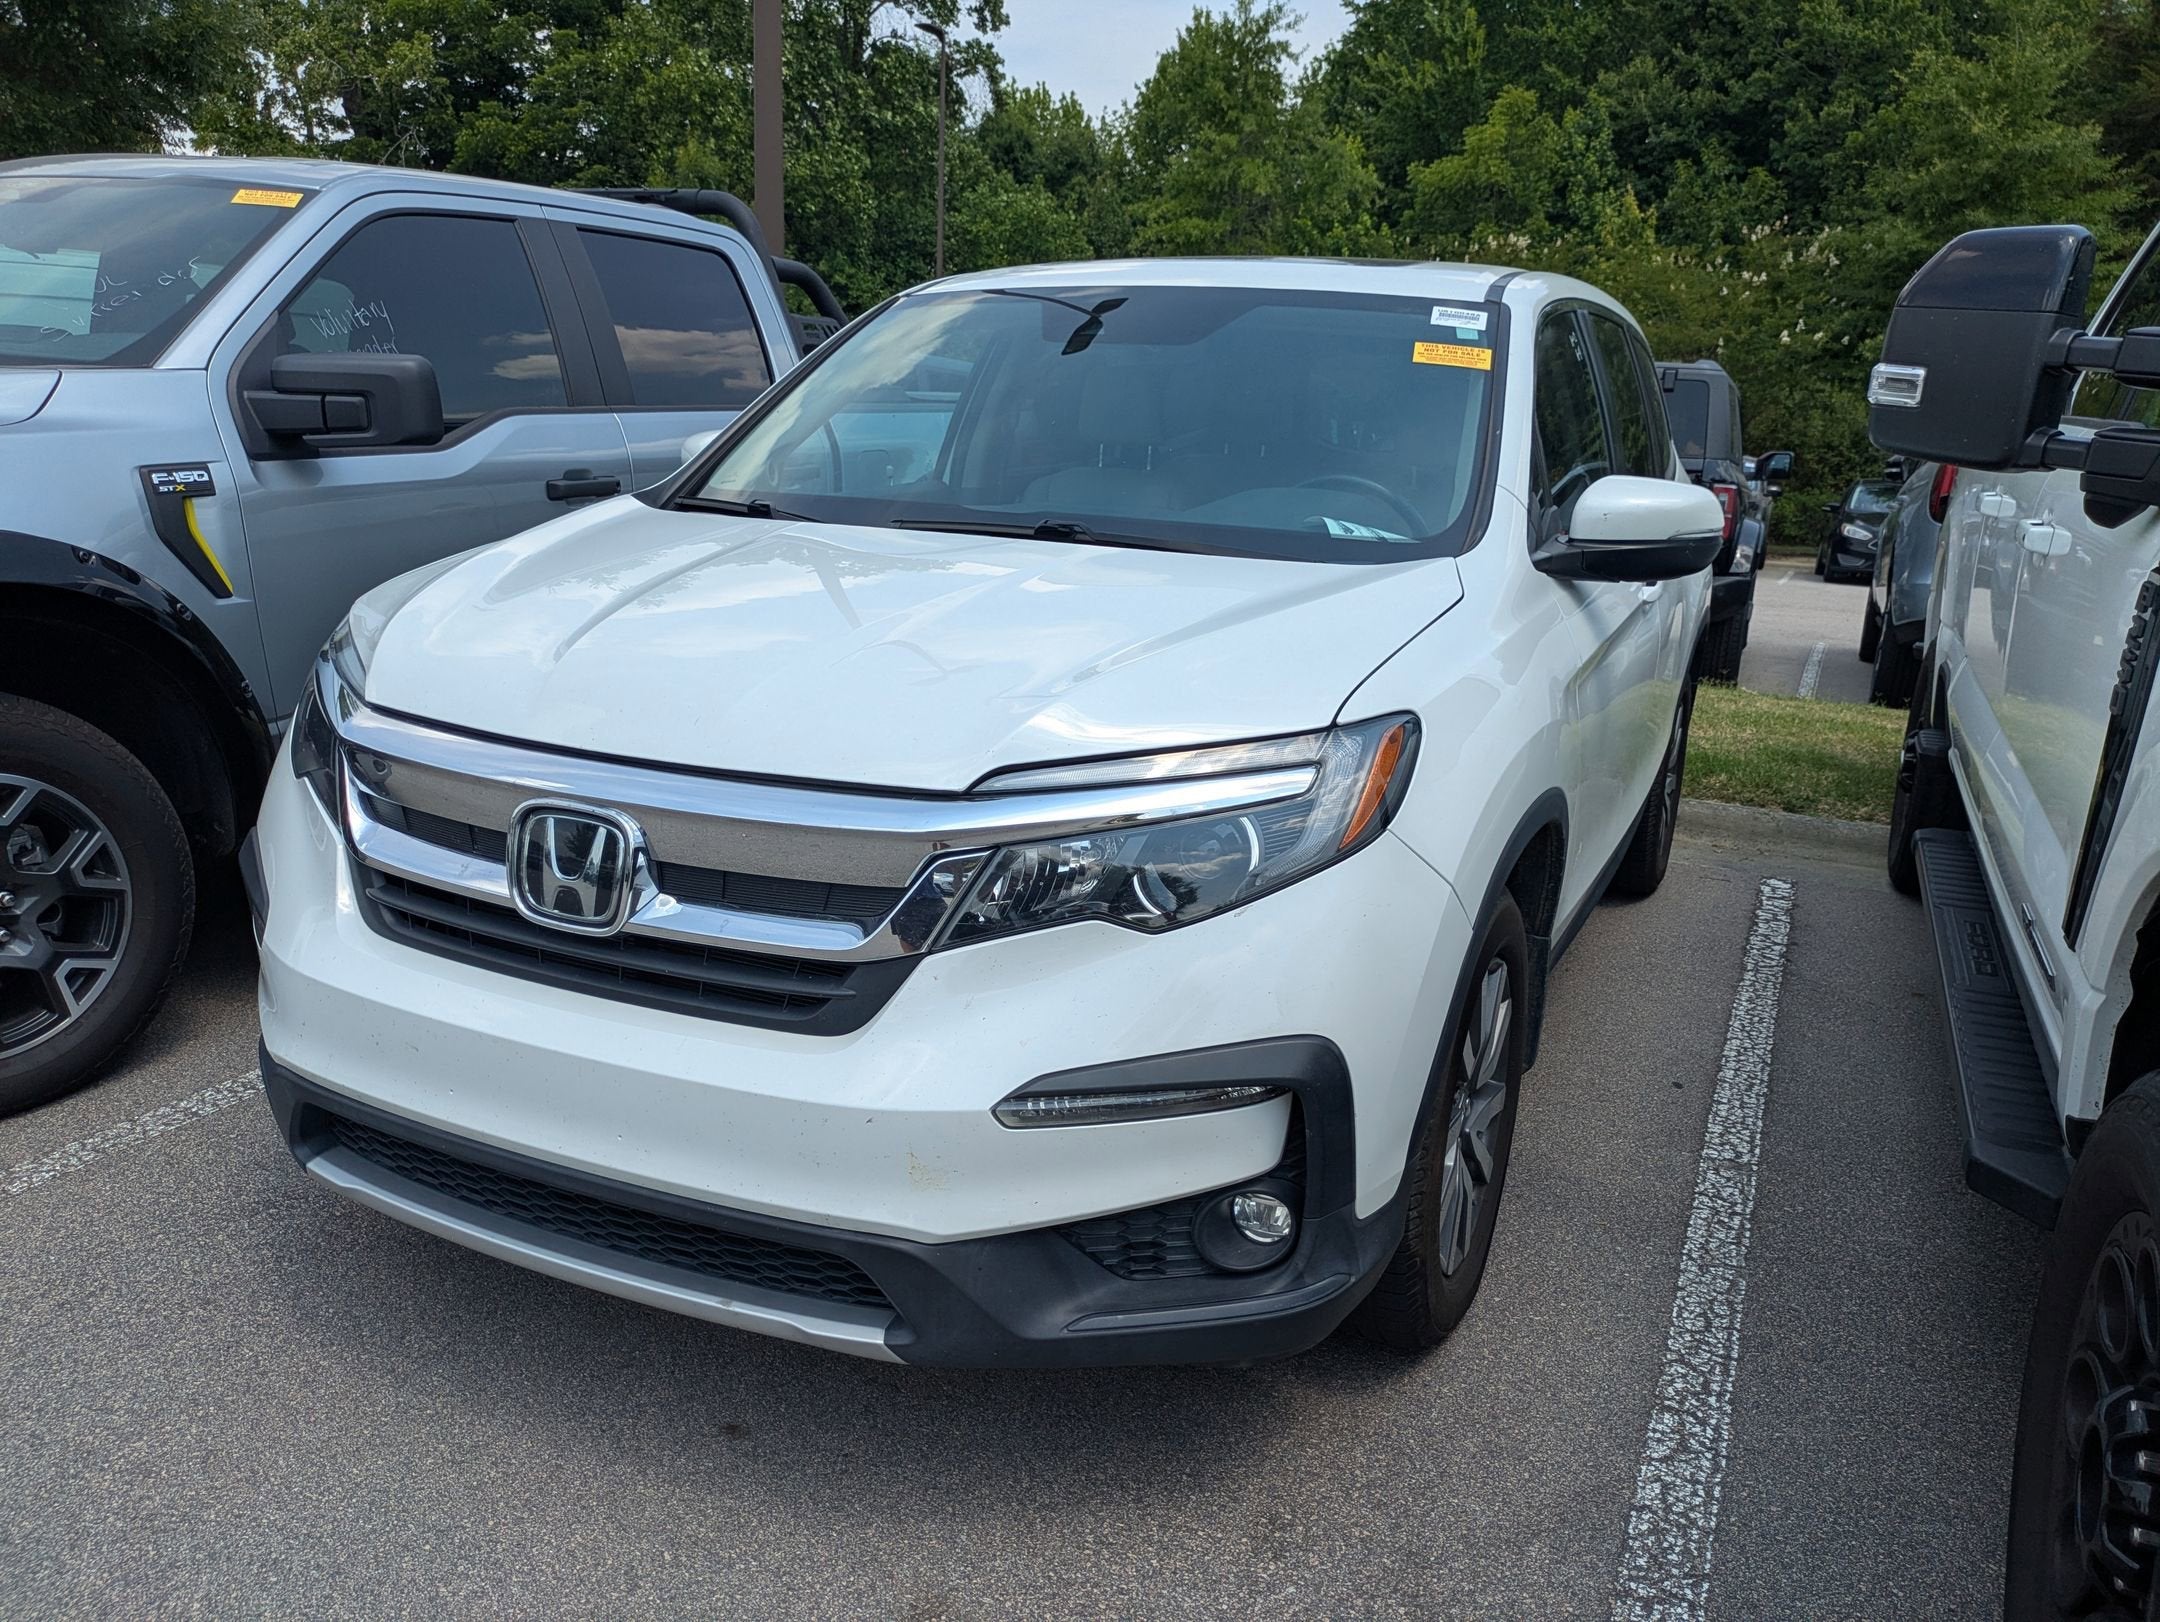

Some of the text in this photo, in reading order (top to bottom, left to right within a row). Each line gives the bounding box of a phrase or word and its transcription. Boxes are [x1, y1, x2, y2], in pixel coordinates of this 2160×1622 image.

[1442, 345, 1476, 353] VEHICLE
[152, 470, 210, 484] F-150
[159, 484, 187, 492] STX
